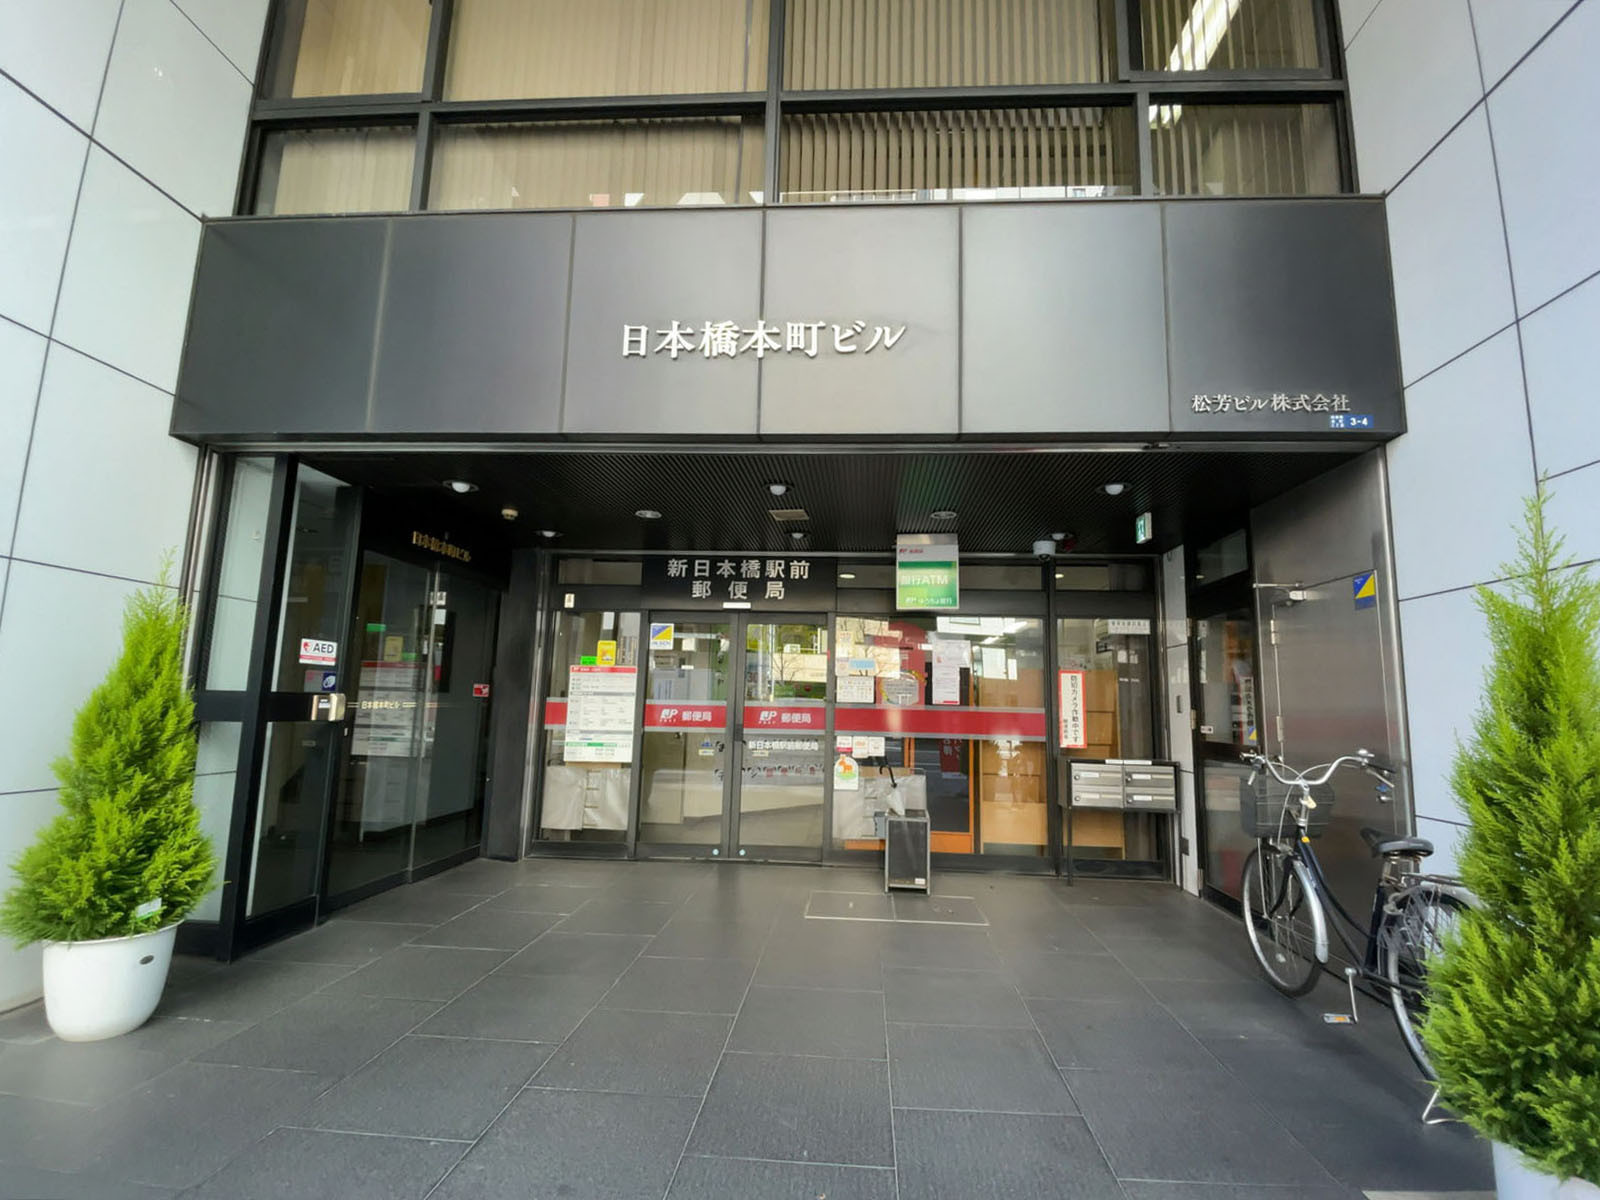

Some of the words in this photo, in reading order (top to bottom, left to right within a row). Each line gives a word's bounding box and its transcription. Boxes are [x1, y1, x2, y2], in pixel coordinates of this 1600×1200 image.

[621, 320, 907, 359] 日本橋本町ビル
[1191, 393, 1351, 413] 松芳ビル株式会社
[1350, 416, 1369, 427] 3-4
[666, 558, 811, 580] 新日本橋駅前
[691, 580, 786, 600] 郵便局
[312, 643, 335, 654] AED
[681, 710, 713, 722] 郵便局
[781, 712, 812, 724] 郵便局
